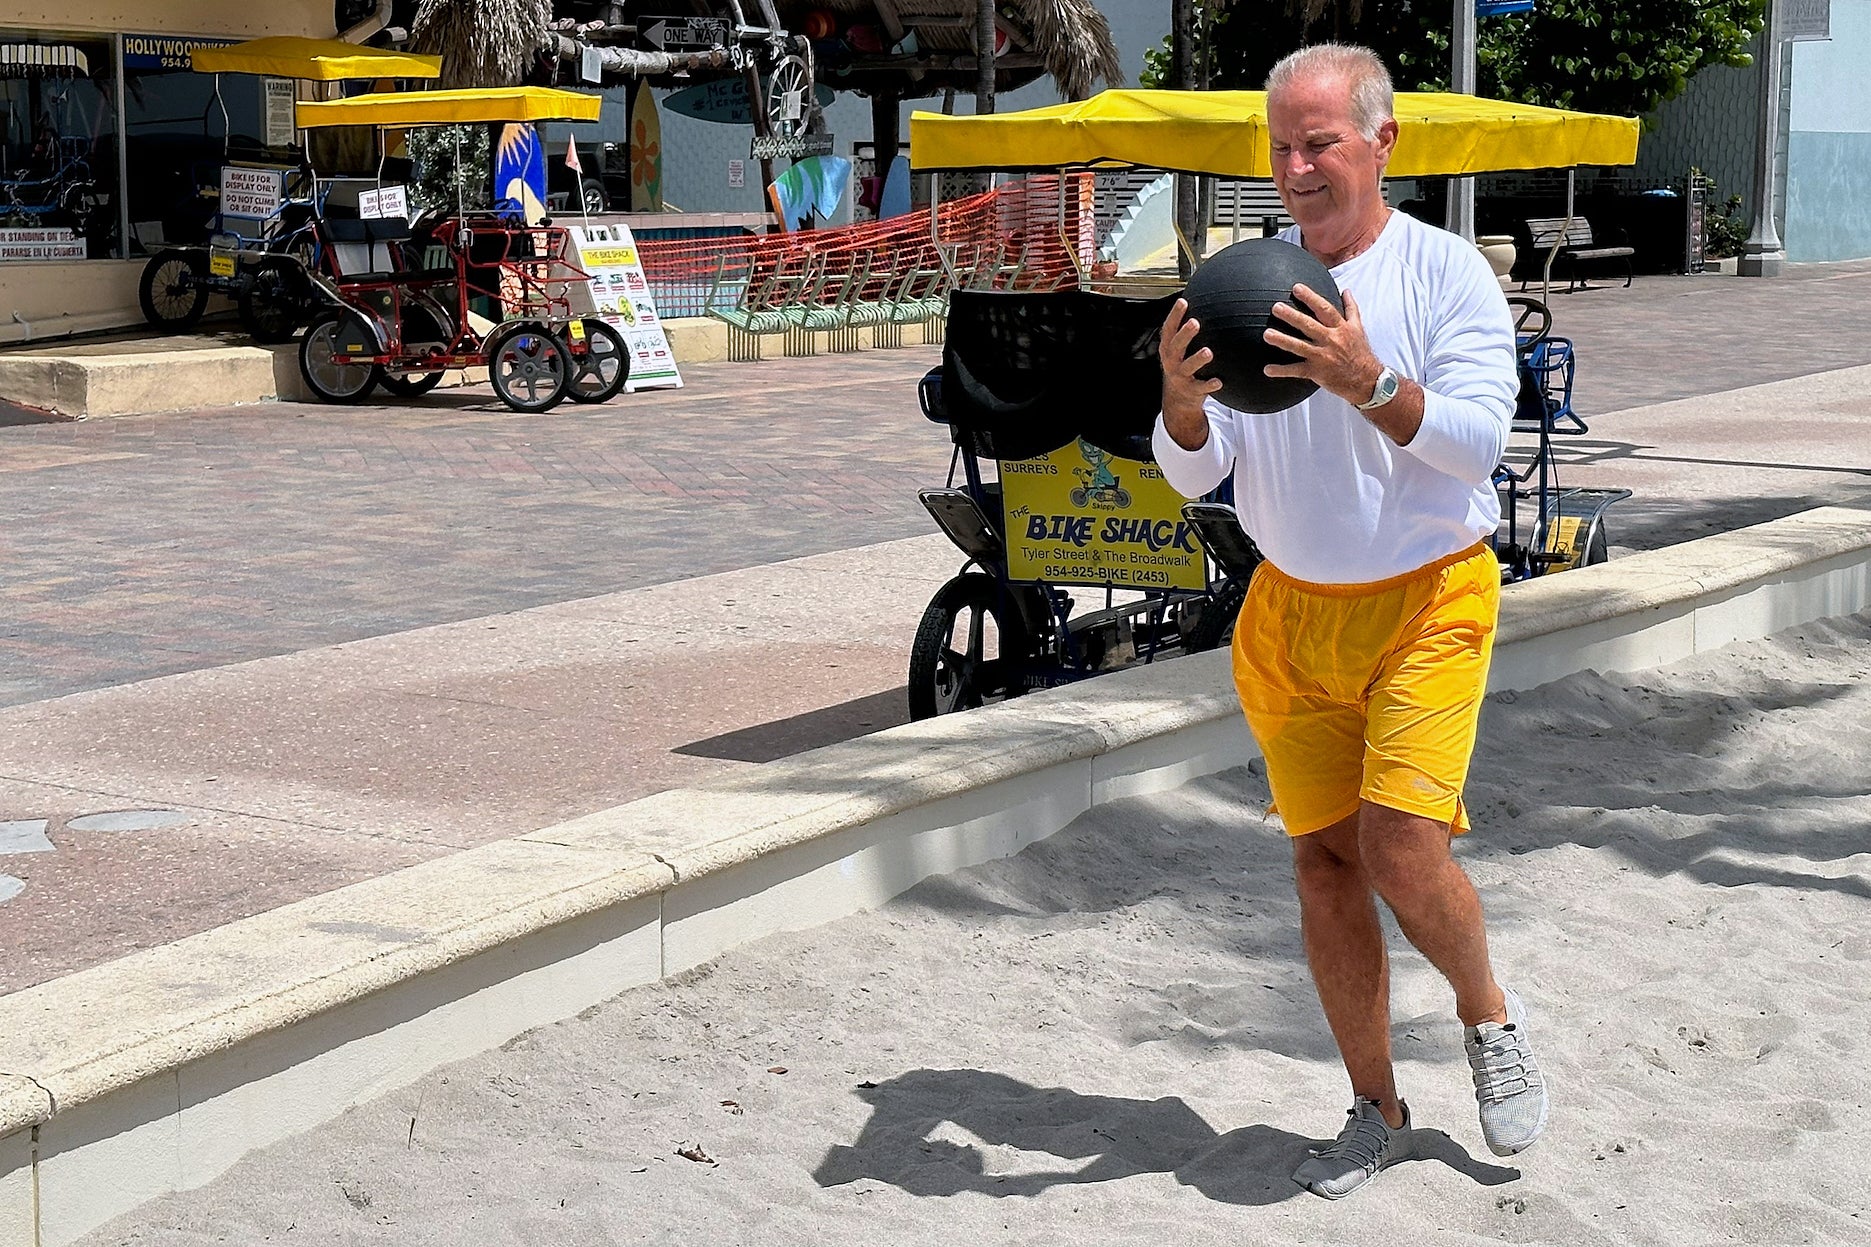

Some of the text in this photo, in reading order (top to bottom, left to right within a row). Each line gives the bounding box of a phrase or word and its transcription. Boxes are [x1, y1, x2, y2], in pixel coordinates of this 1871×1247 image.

[664, 29, 719, 43] ONE WAY
[231, 172, 248, 181] BIKE
[257, 175, 271, 183] FOR
[225, 181, 276, 193] DISPLAY ONLY
[226, 194, 275, 206] DO NOT CLIMB
[230, 204, 239, 212] OR
[242, 205, 251, 213] SIT
[252, 206, 263, 214] ON
[363, 203, 385, 213] DISPLY
[47, 232, 58, 242] ON
[60, 232, 79, 241] DEC
[1004, 463, 1058, 475] SURREYS
[1010, 505, 1030, 519] THE
[1025, 514, 1198, 554] BIKE SHACK
[1021, 547, 1191, 567] Tyler Street & The Broadwalk
[1045, 565, 1169, 585] 954-925-BIKE (2453)
